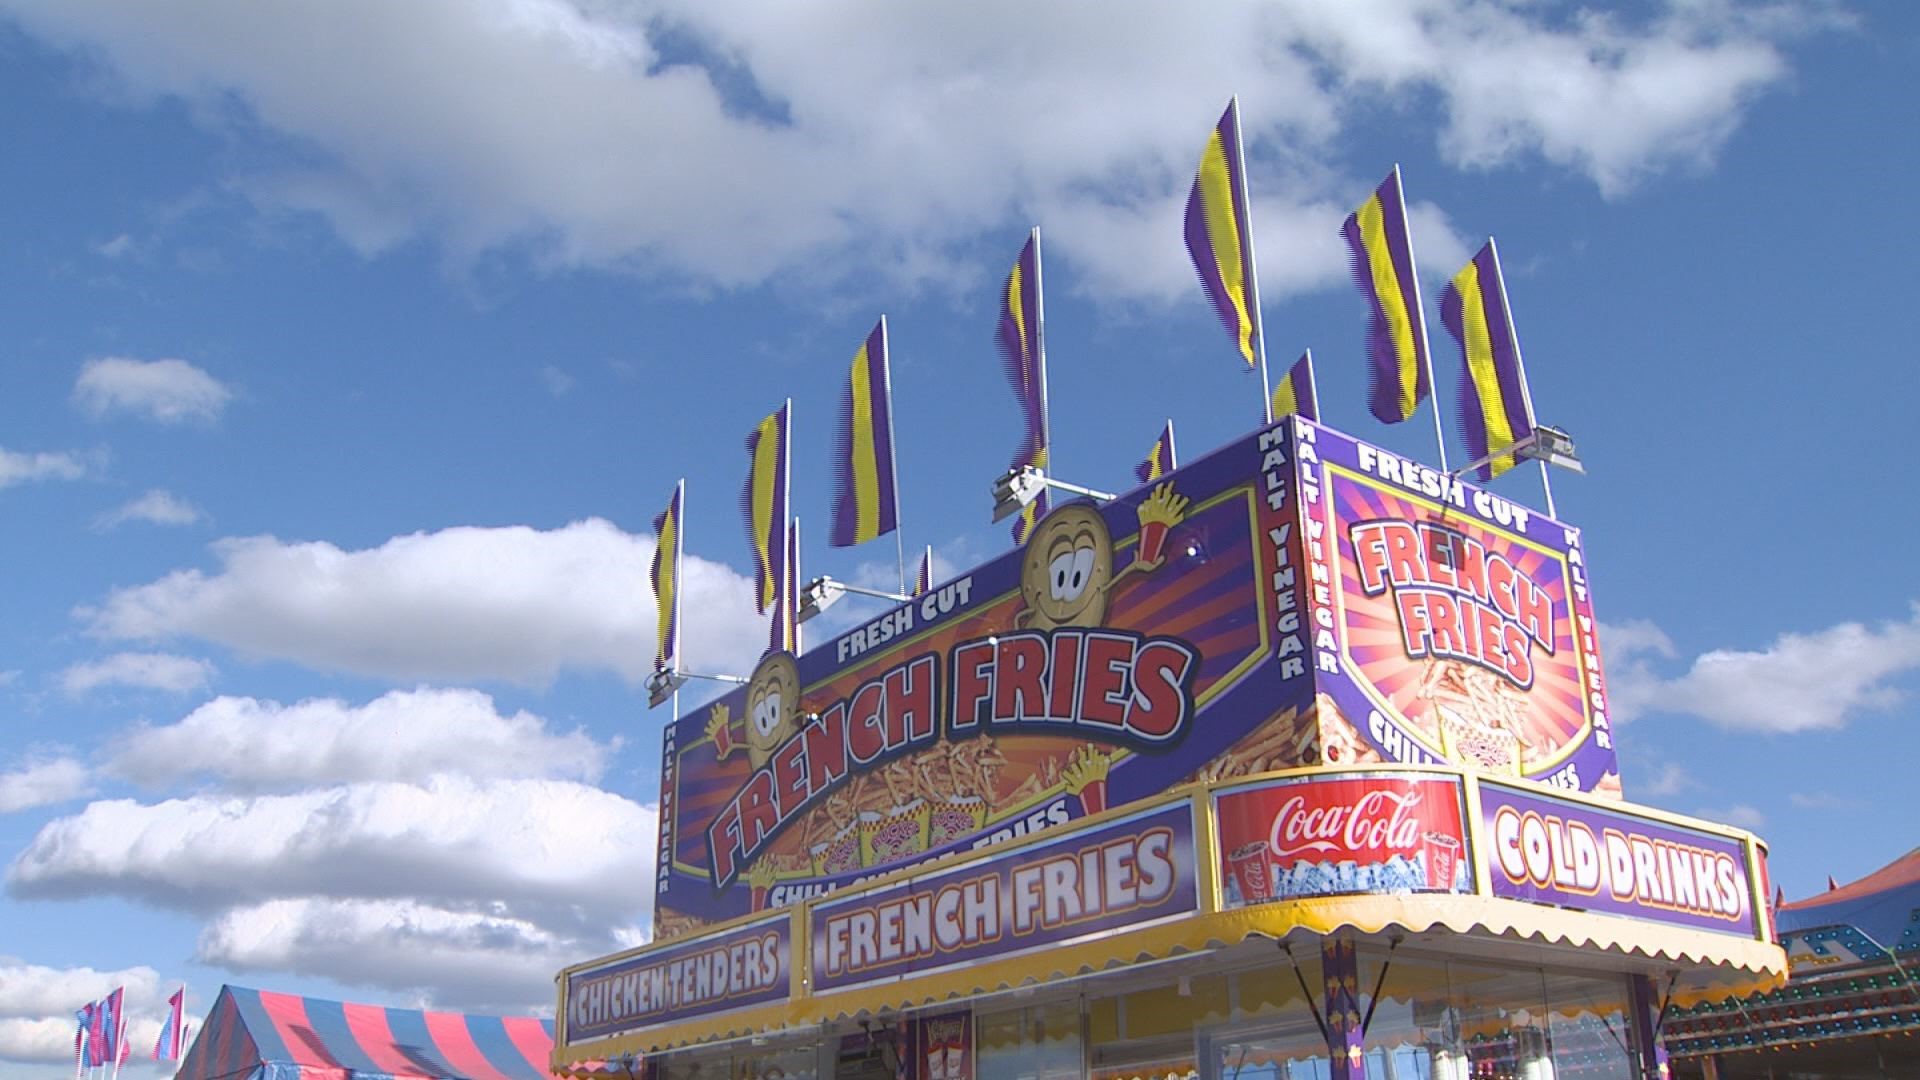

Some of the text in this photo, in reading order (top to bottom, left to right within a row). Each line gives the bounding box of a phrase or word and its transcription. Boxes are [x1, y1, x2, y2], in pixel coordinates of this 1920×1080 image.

[1296, 420, 1339, 675] MALT VINEGAR
[1357, 443, 1529, 532] FRESH CUT
[1259, 425, 1304, 680] MALT VINEGAR
[1352, 522, 1553, 654] FRENCH
[838, 577, 973, 663] FRESH CUT
[1396, 589, 1532, 687] FRIES
[1564, 529, 1612, 750] MALT VINEGAR
[710, 632, 1194, 888] FRENCH FRIES
[1368, 709, 1433, 764] CHI
[659, 725, 677, 893] MALT VINEGAR
[1270, 790, 1424, 856] Coca-Cola
[1496, 807, 1741, 921] COLD DRINKS
[827, 830, 1174, 975] FRENCH FRIES
[576, 935, 778, 1029] CHICKEN TENDERS
